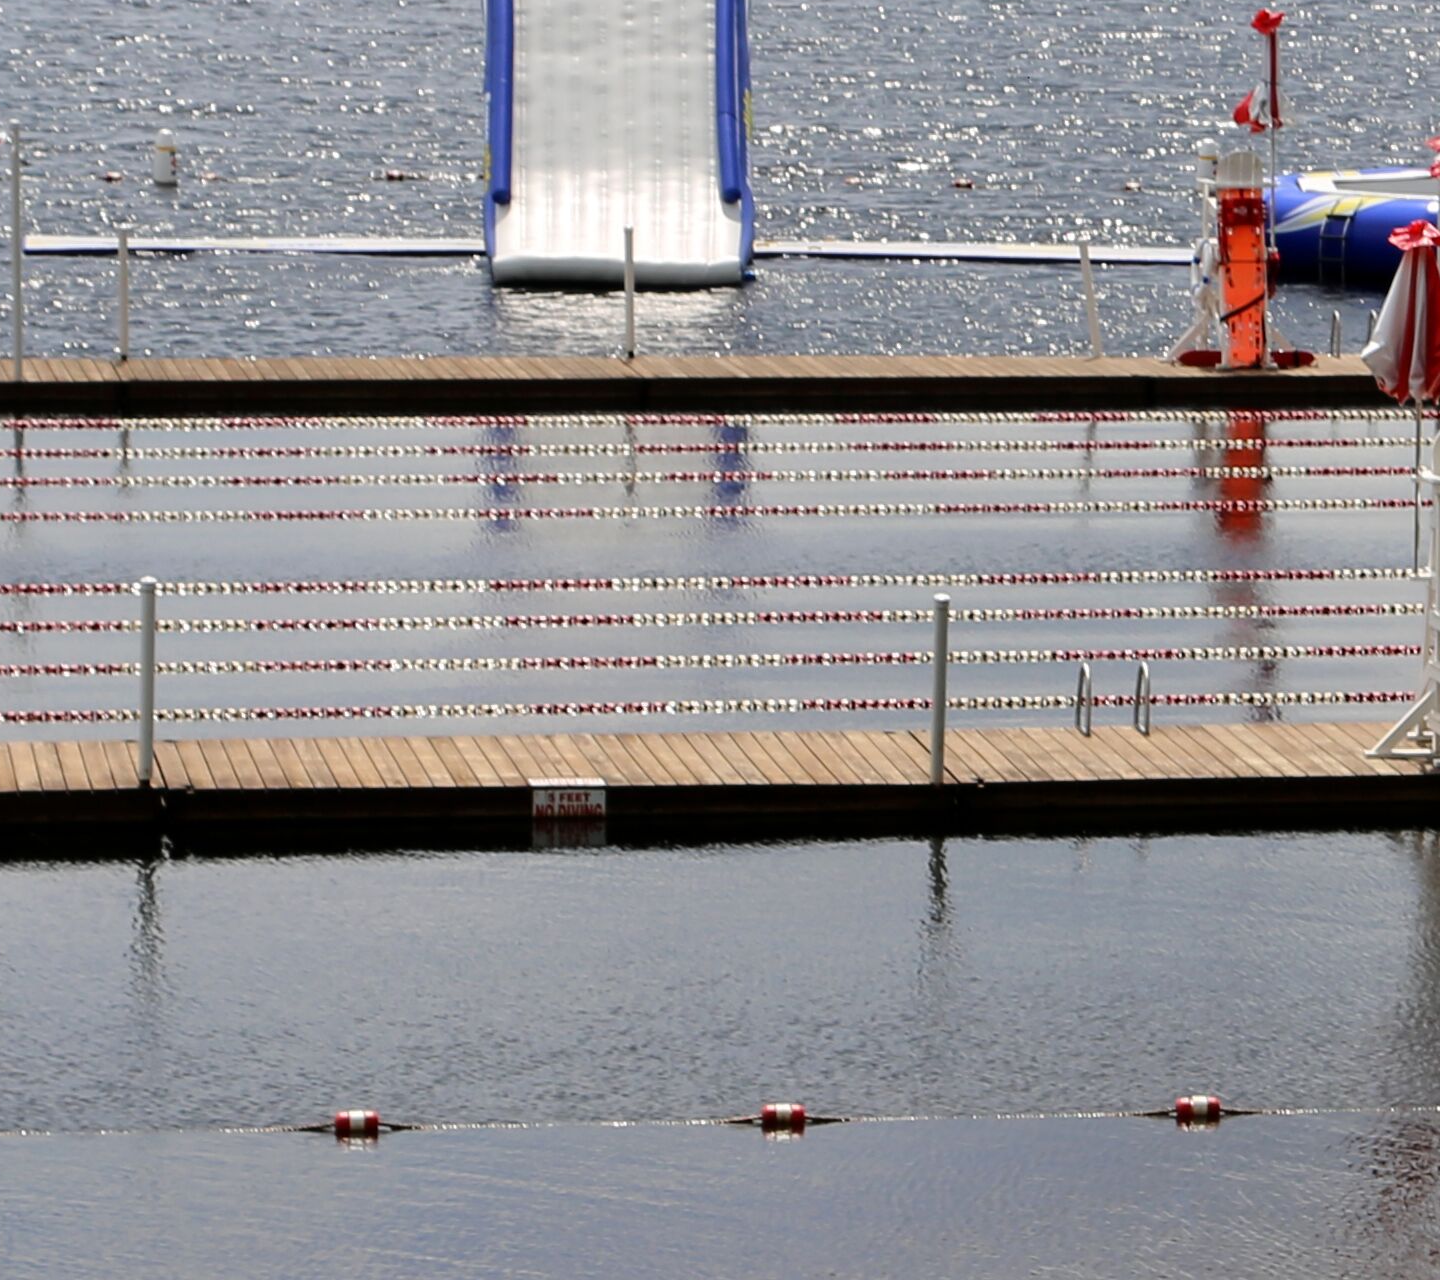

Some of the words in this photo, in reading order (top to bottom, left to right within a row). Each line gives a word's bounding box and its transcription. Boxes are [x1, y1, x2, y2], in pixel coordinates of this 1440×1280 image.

[559, 792, 591, 802] FEET
[535, 804, 554, 817] NO
[558, 804, 603, 817] DIVING
